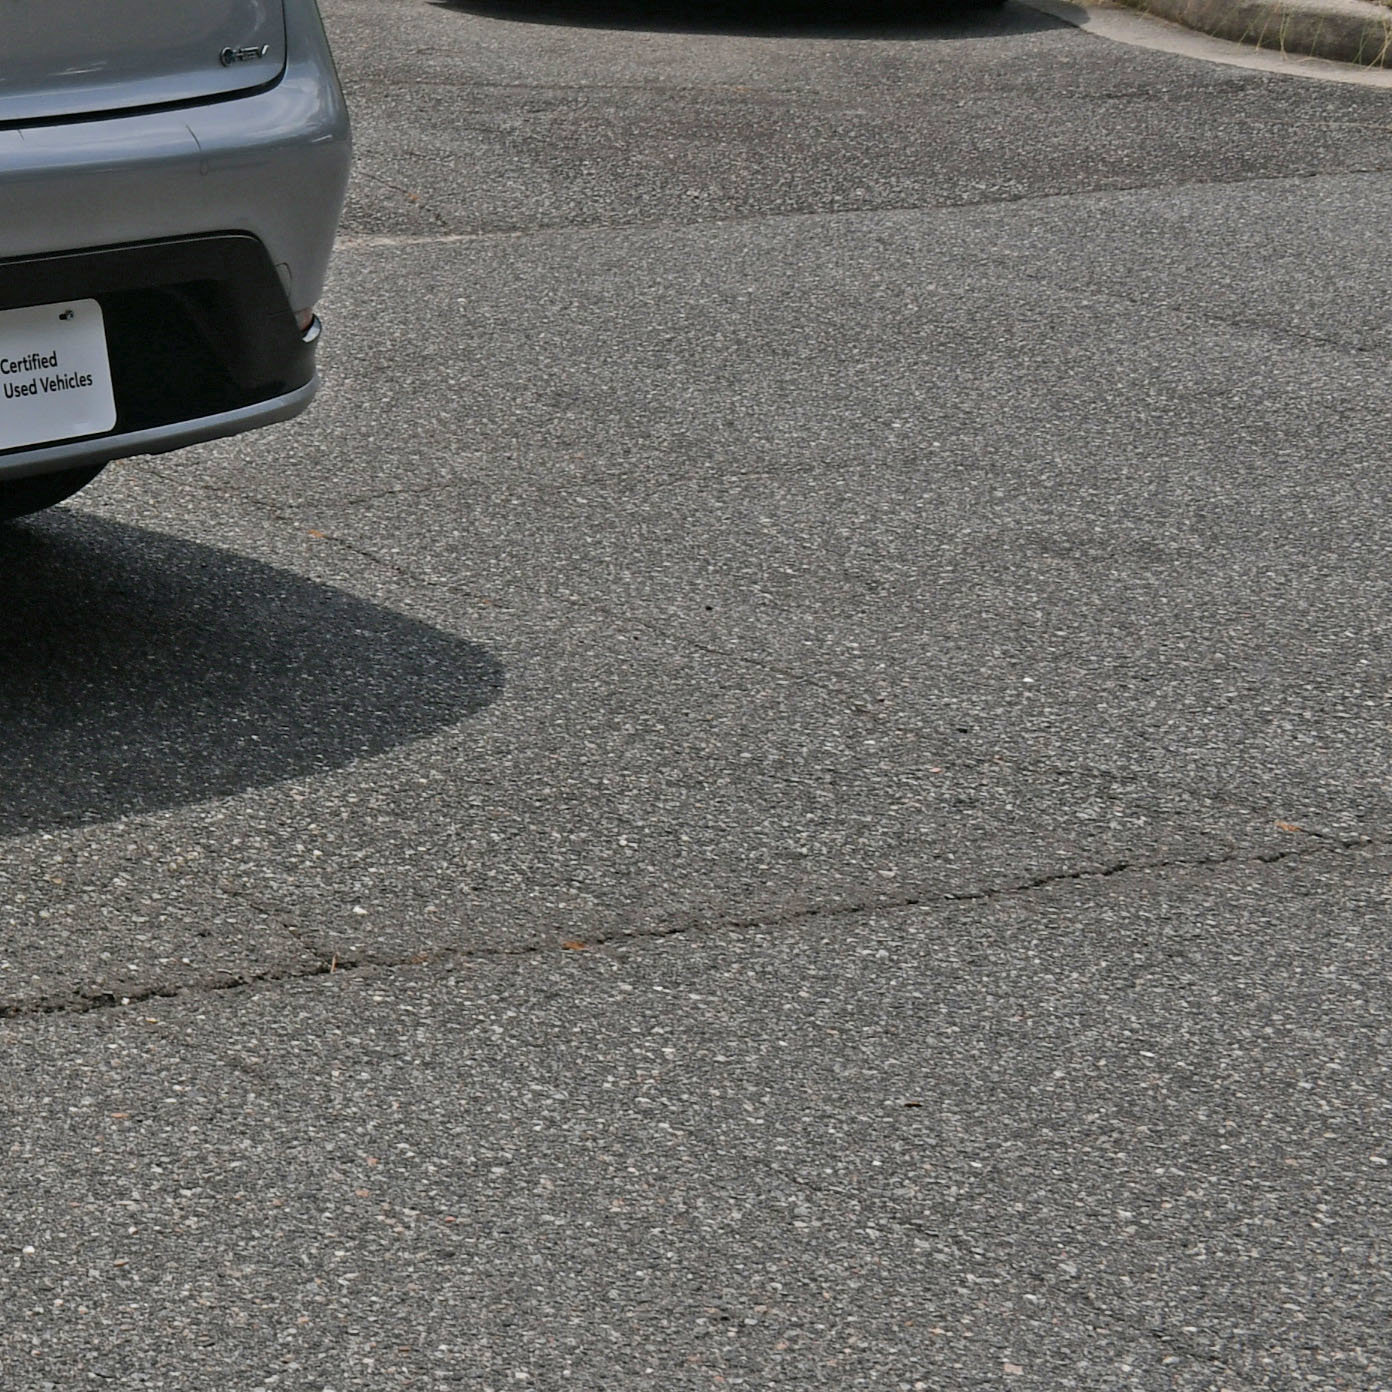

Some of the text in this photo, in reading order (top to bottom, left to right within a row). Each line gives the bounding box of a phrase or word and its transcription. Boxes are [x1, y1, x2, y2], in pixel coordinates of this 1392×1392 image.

[0, 350, 58, 374] Certified
[4, 371, 93, 398] Used Vehicles
